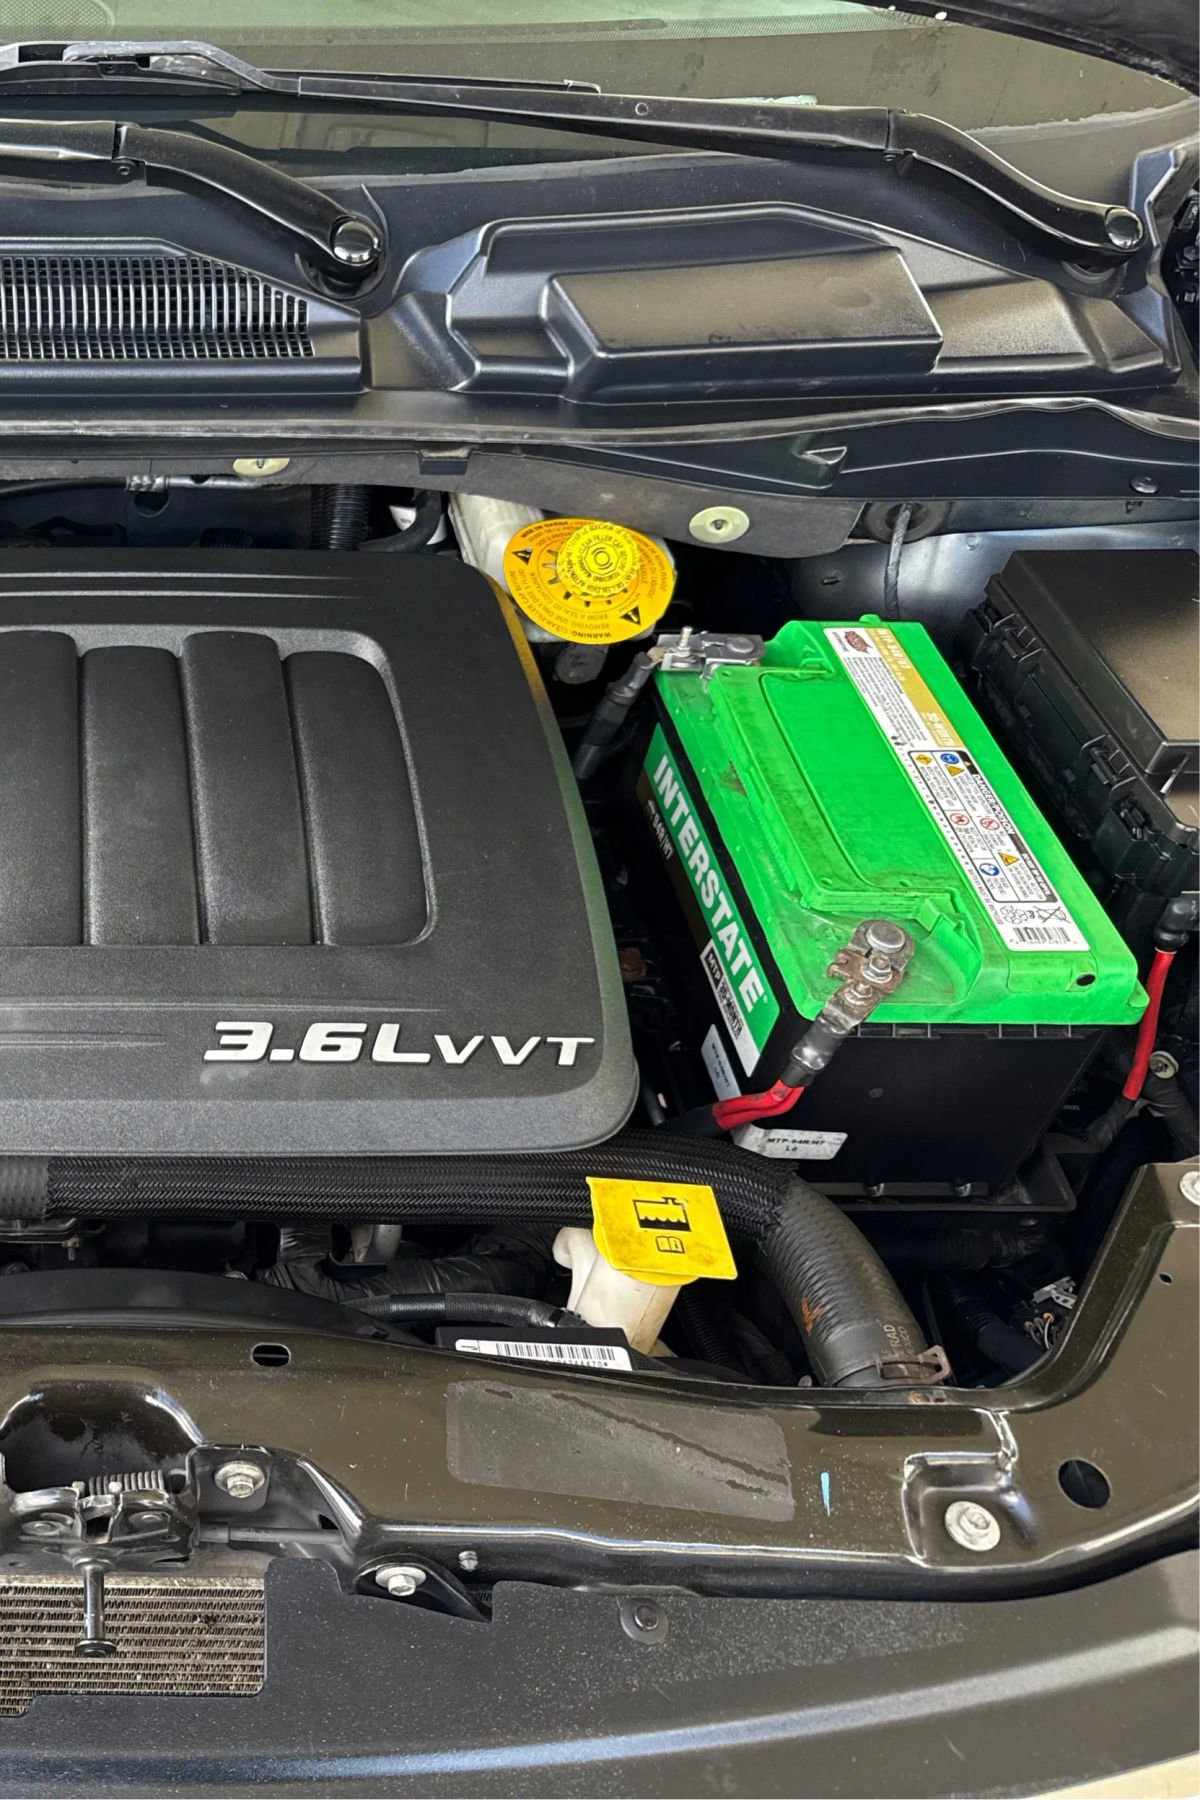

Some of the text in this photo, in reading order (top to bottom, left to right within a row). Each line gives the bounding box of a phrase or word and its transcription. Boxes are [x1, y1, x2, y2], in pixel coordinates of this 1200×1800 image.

[653, 755, 765, 1013] INTERSTATE
[708, 954, 721, 981] MTP
[433, 1034, 596, 1066] VVT
